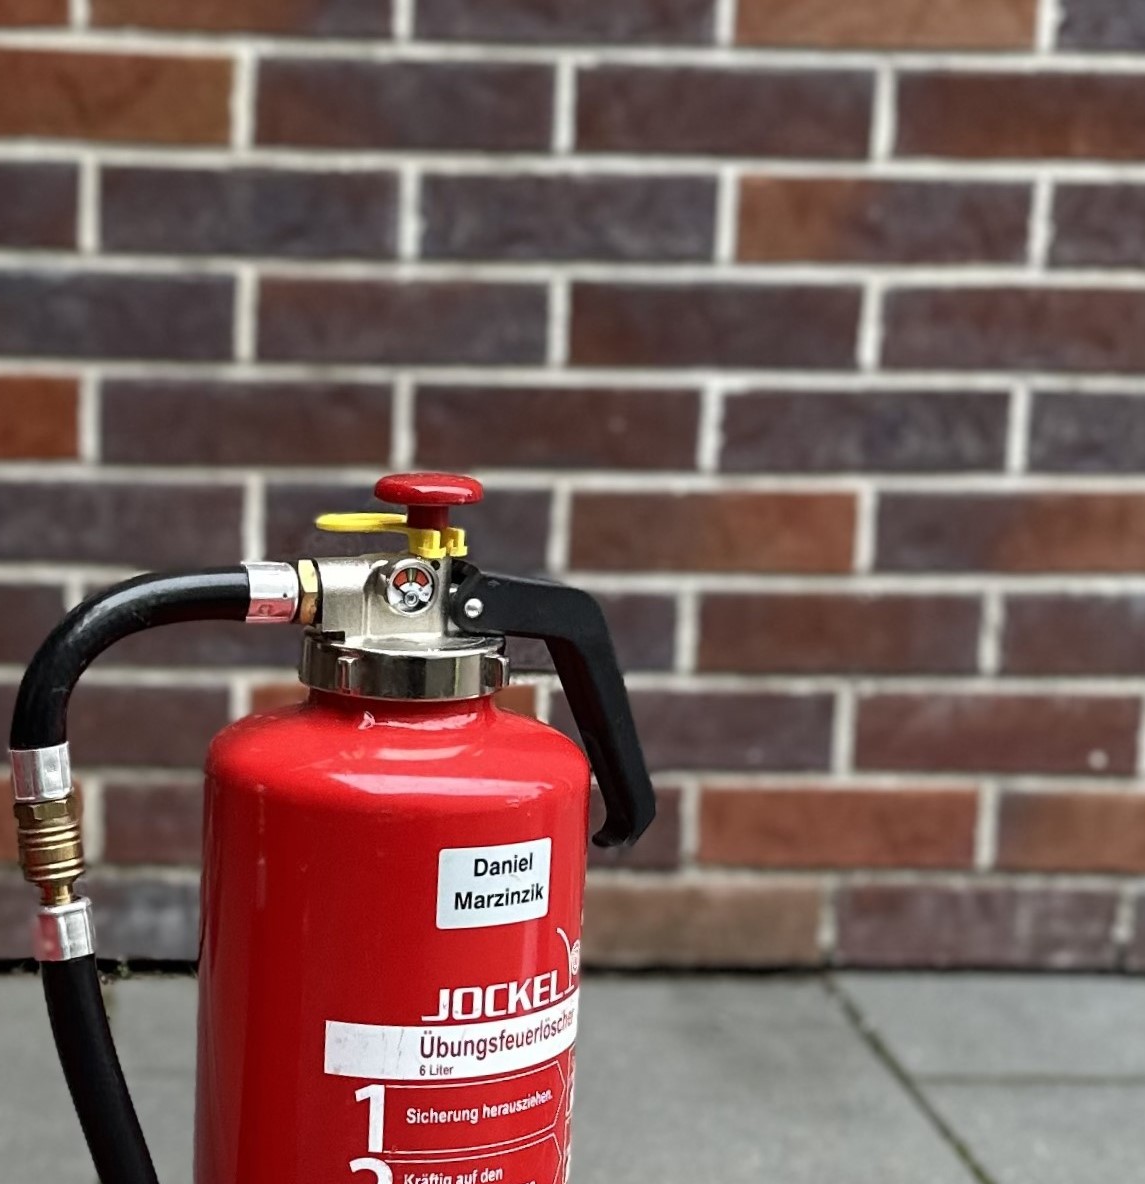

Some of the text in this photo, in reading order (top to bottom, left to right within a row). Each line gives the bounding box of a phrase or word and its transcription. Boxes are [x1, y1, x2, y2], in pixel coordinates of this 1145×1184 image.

[473, 852, 533, 877] Daniel
[454, 883, 544, 911] Marzinzik
[421, 970, 564, 1022] JOCKEL
[419, 1008, 575, 1060] Übungsfeuerlöscher
[419, 1064, 453, 1077] 6 Liter
[355, 1084, 386, 1153] 1
[406, 1088, 553, 1124] Sicherung herausziehen.
[480, 1167, 503, 1183] den
